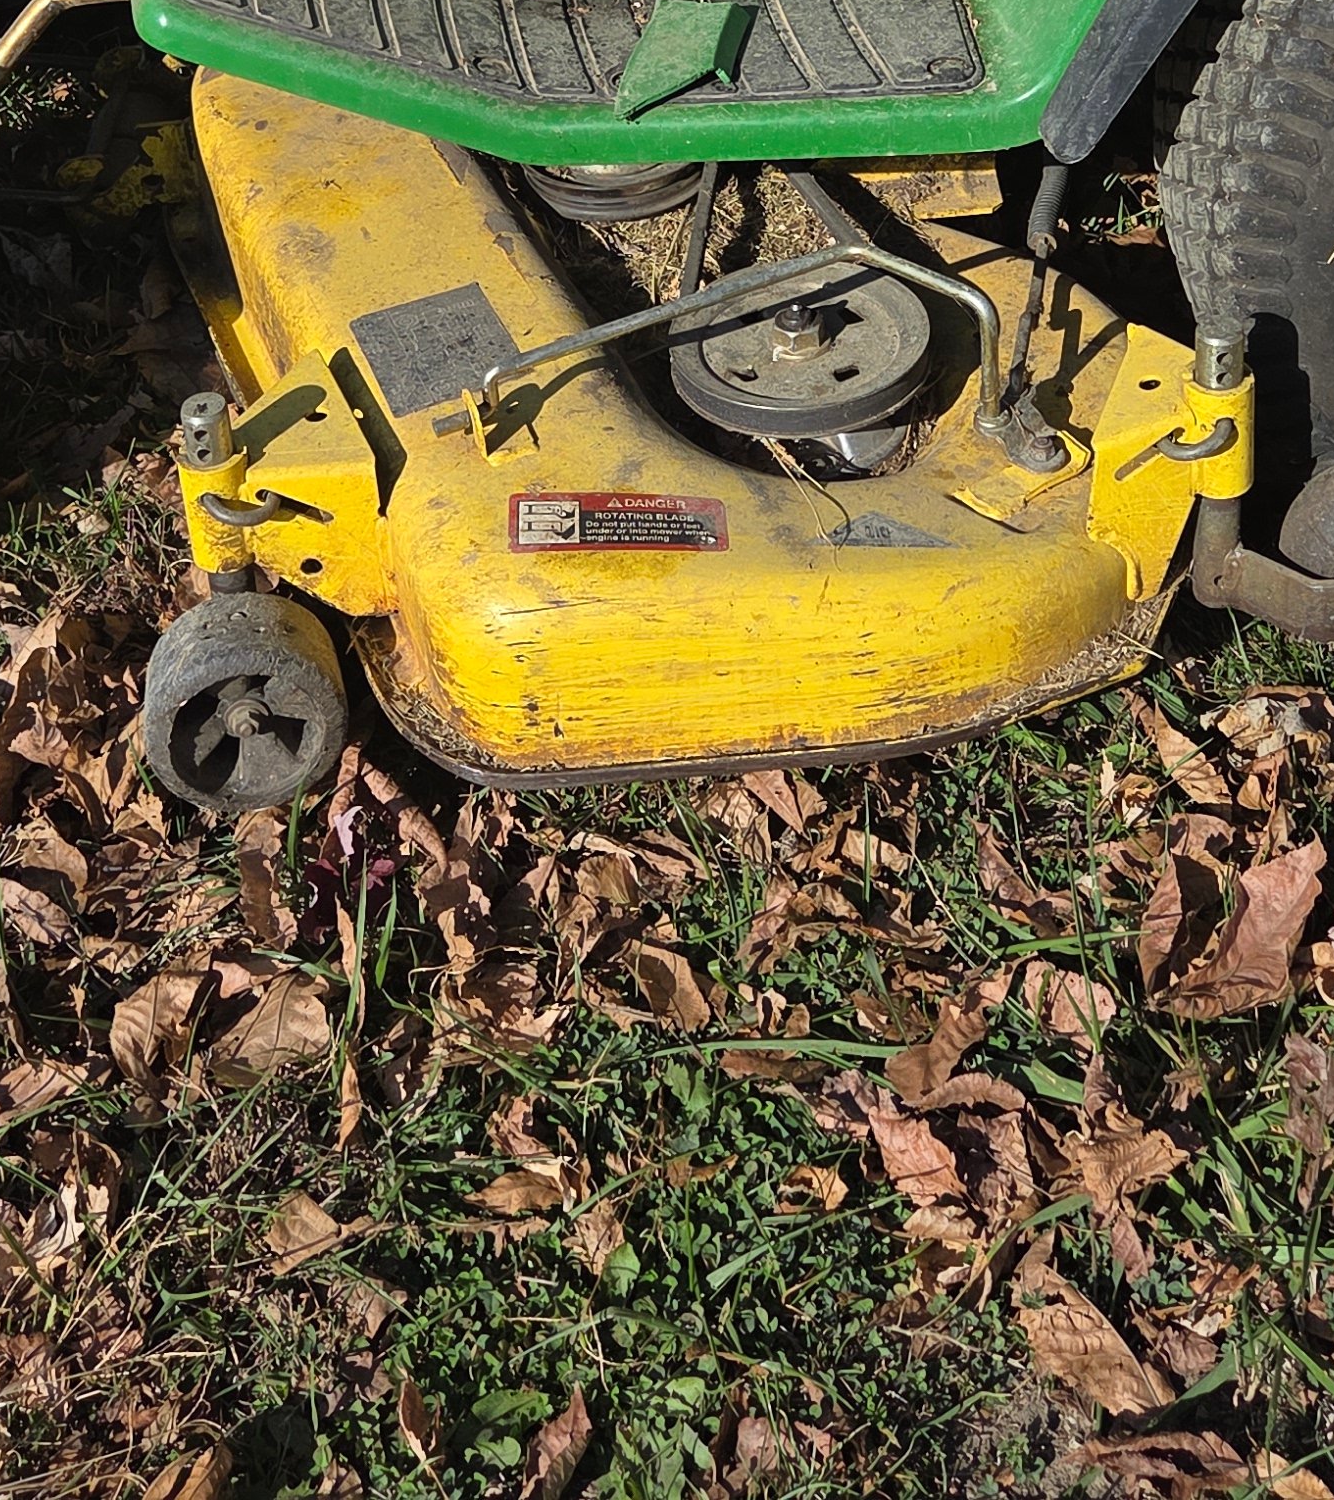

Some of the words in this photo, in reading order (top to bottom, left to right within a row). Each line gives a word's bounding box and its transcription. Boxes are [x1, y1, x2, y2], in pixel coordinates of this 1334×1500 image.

[624, 498, 687, 509] DANGER
[594, 512, 653, 520] ROTATING
[655, 513, 695, 522] BLADE
[586, 520, 600, 528] Do
[620, 521, 636, 529] put
[586, 534, 618, 542] engine
[632, 534, 670, 543] running
